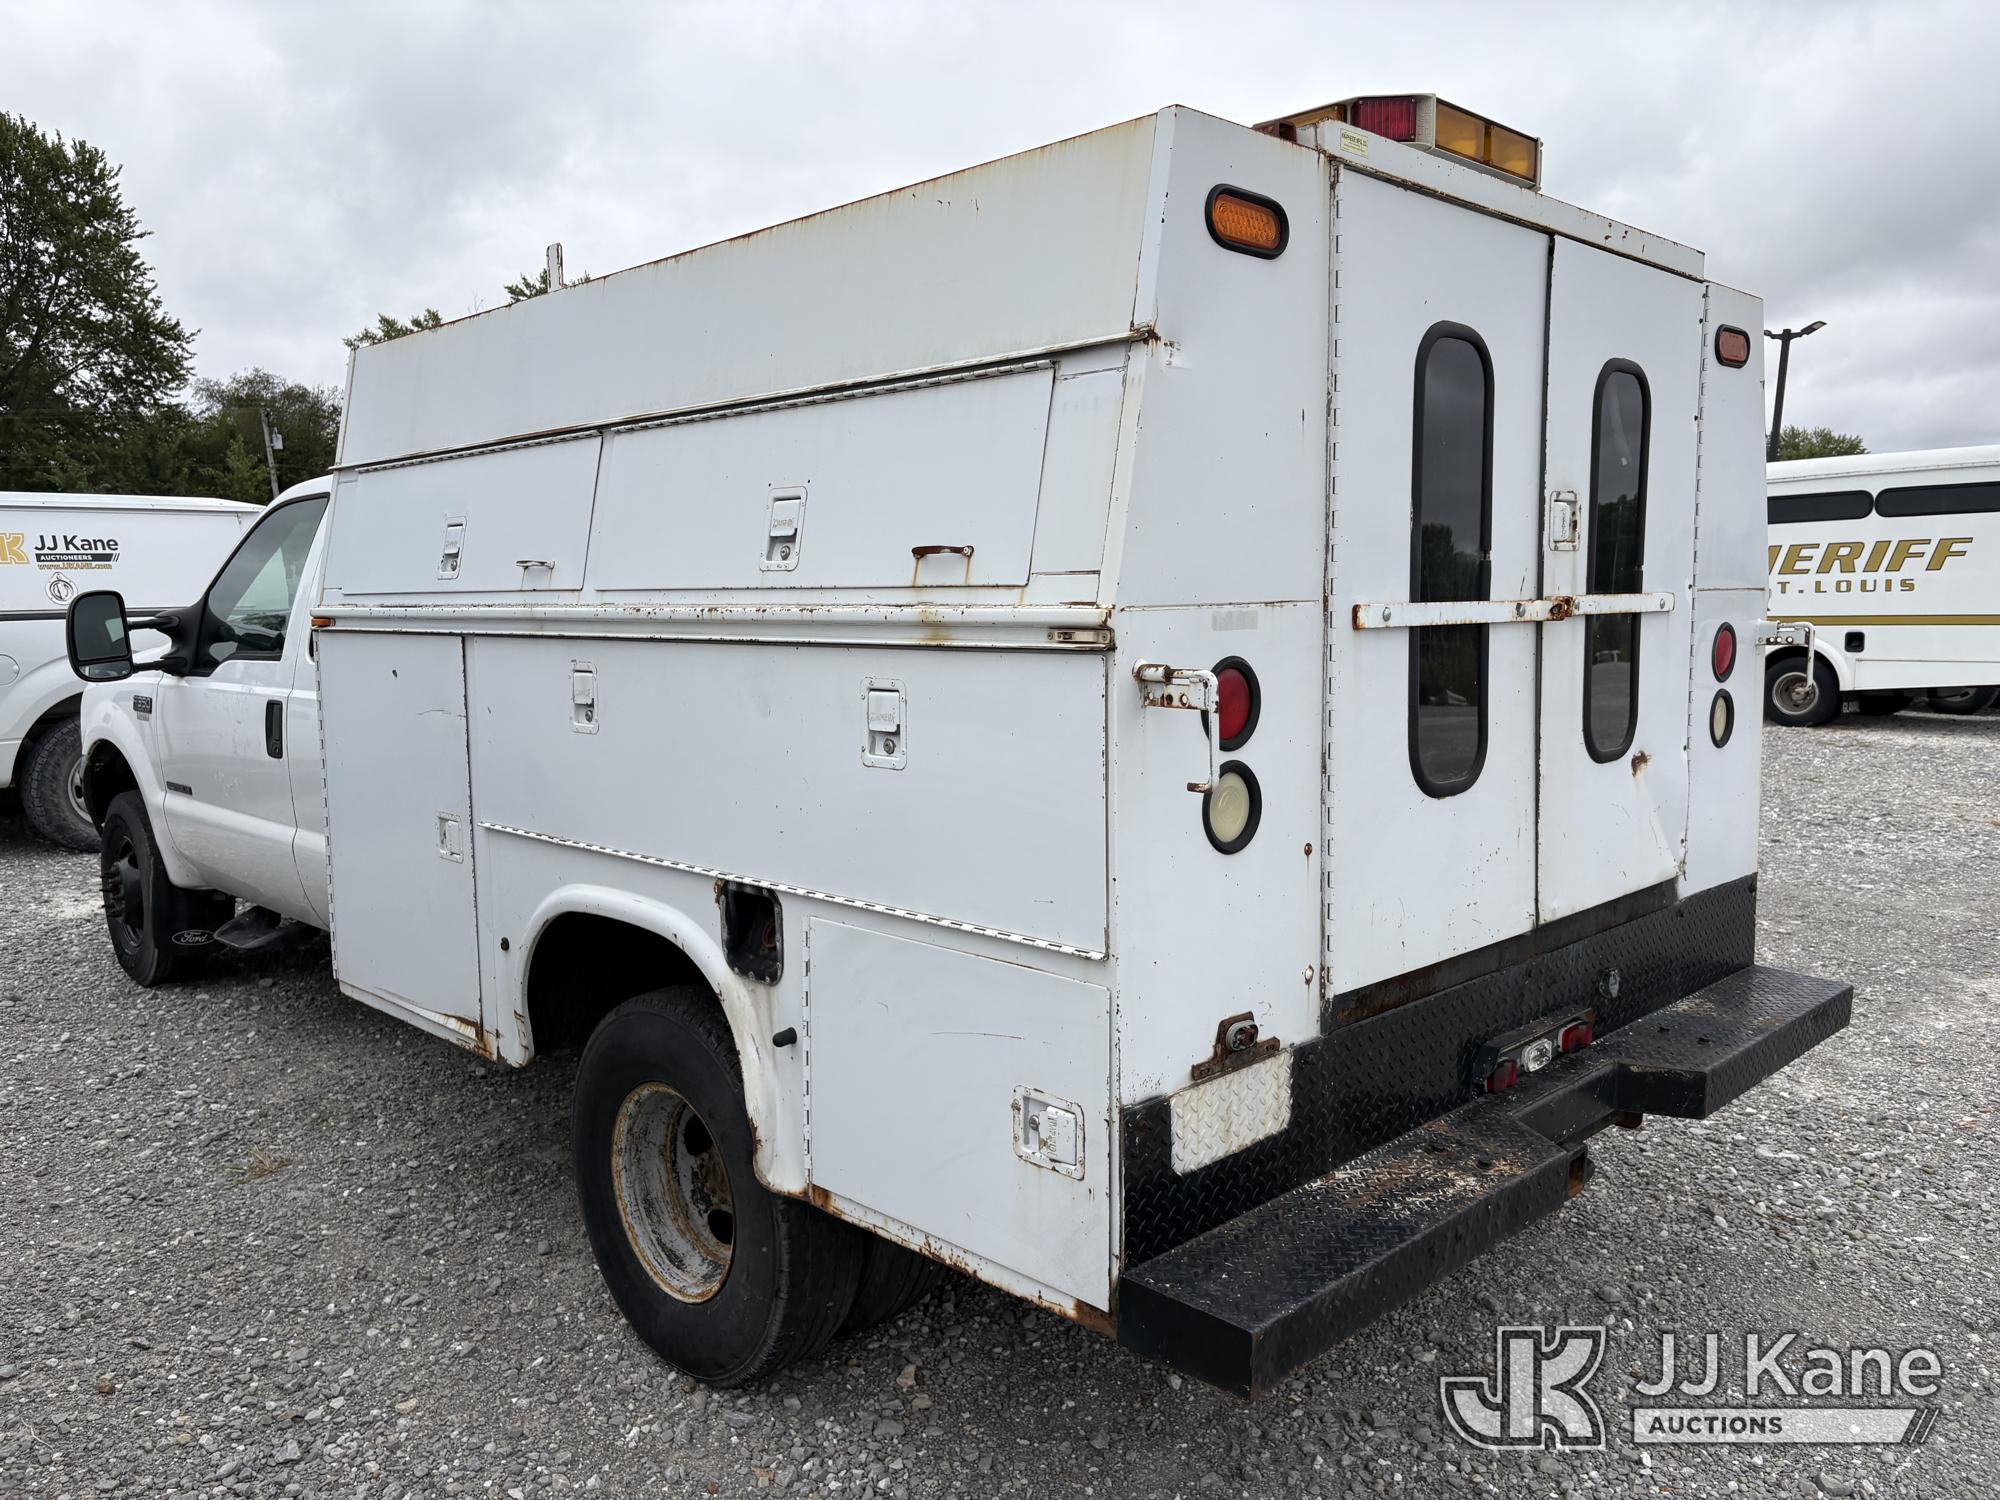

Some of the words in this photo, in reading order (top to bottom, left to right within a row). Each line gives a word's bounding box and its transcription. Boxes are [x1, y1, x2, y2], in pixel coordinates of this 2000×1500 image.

[34, 534, 59, 551] JJ
[62, 534, 119, 551] Kane
[1814, 578, 1916, 594] LOUIS
[180, 931, 208, 943] Ford
